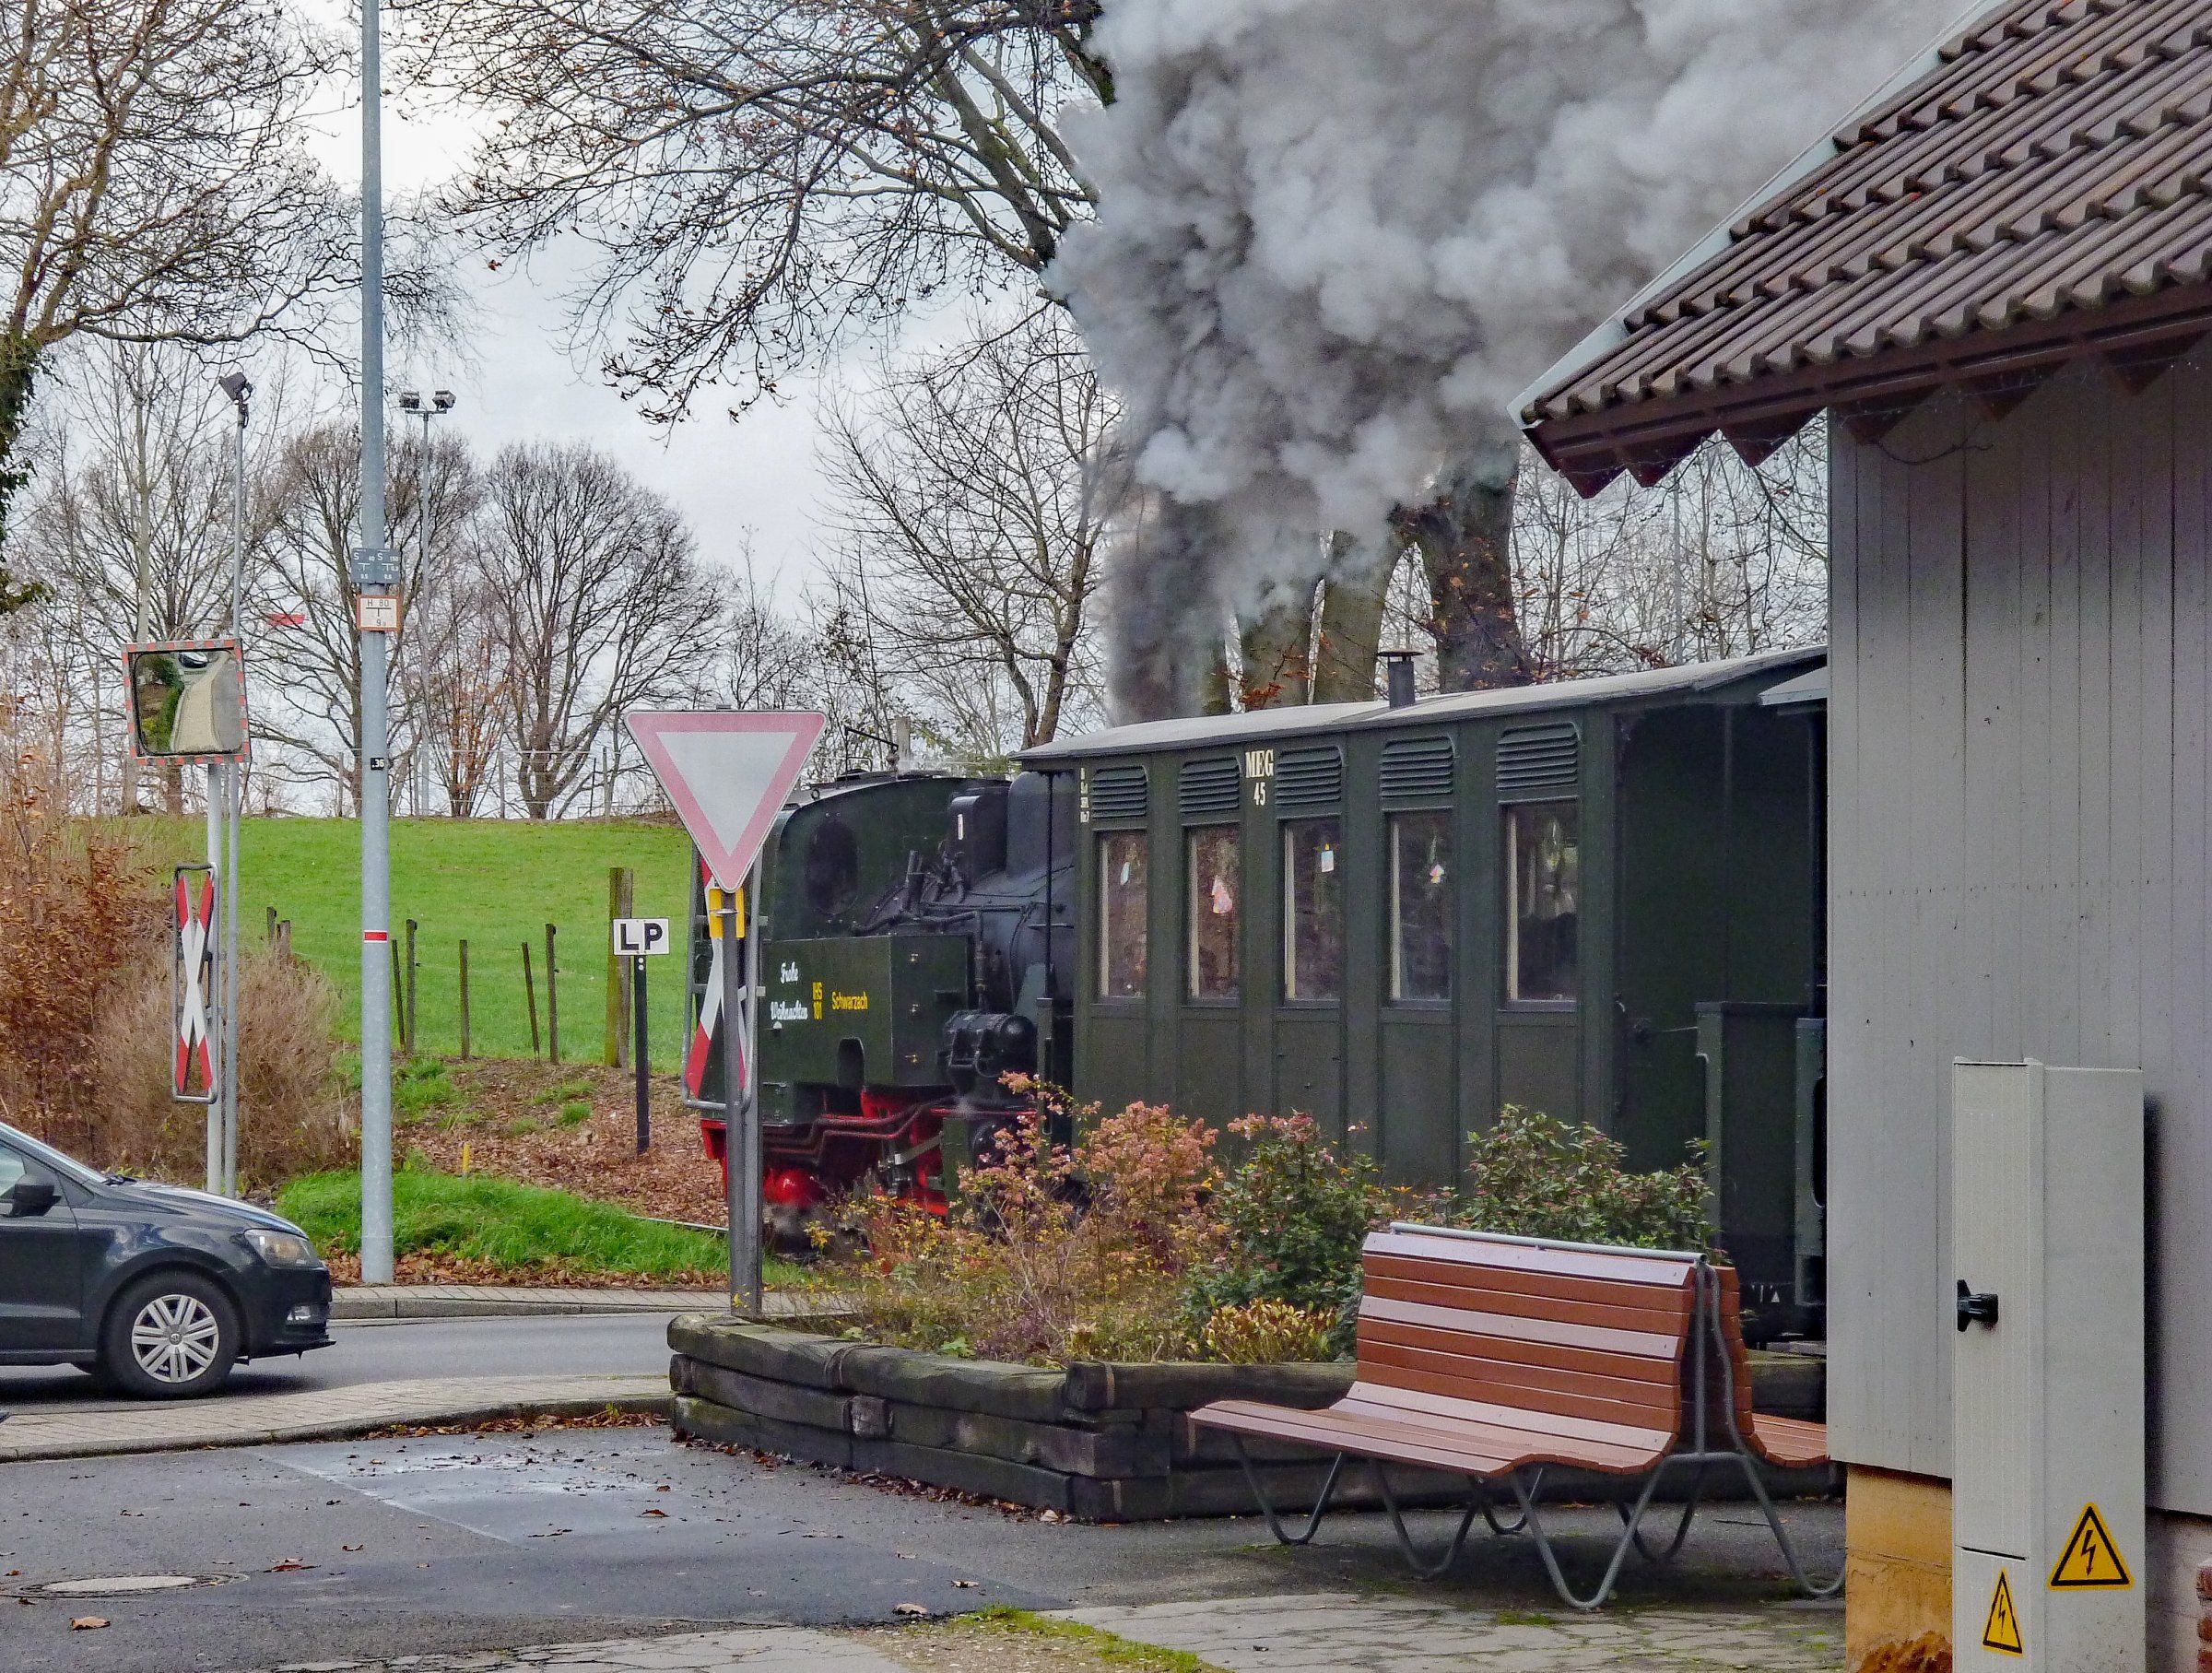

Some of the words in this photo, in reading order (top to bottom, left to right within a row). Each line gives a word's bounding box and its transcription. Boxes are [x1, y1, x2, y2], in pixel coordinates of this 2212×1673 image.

[353, 552, 359, 560] S
[377, 553, 383, 561] S
[1245, 748, 1274, 778] MEG
[1253, 782, 1266, 806] 45
[620, 923, 663, 950] LP
[831, 991, 868, 1009] Schwarzach
